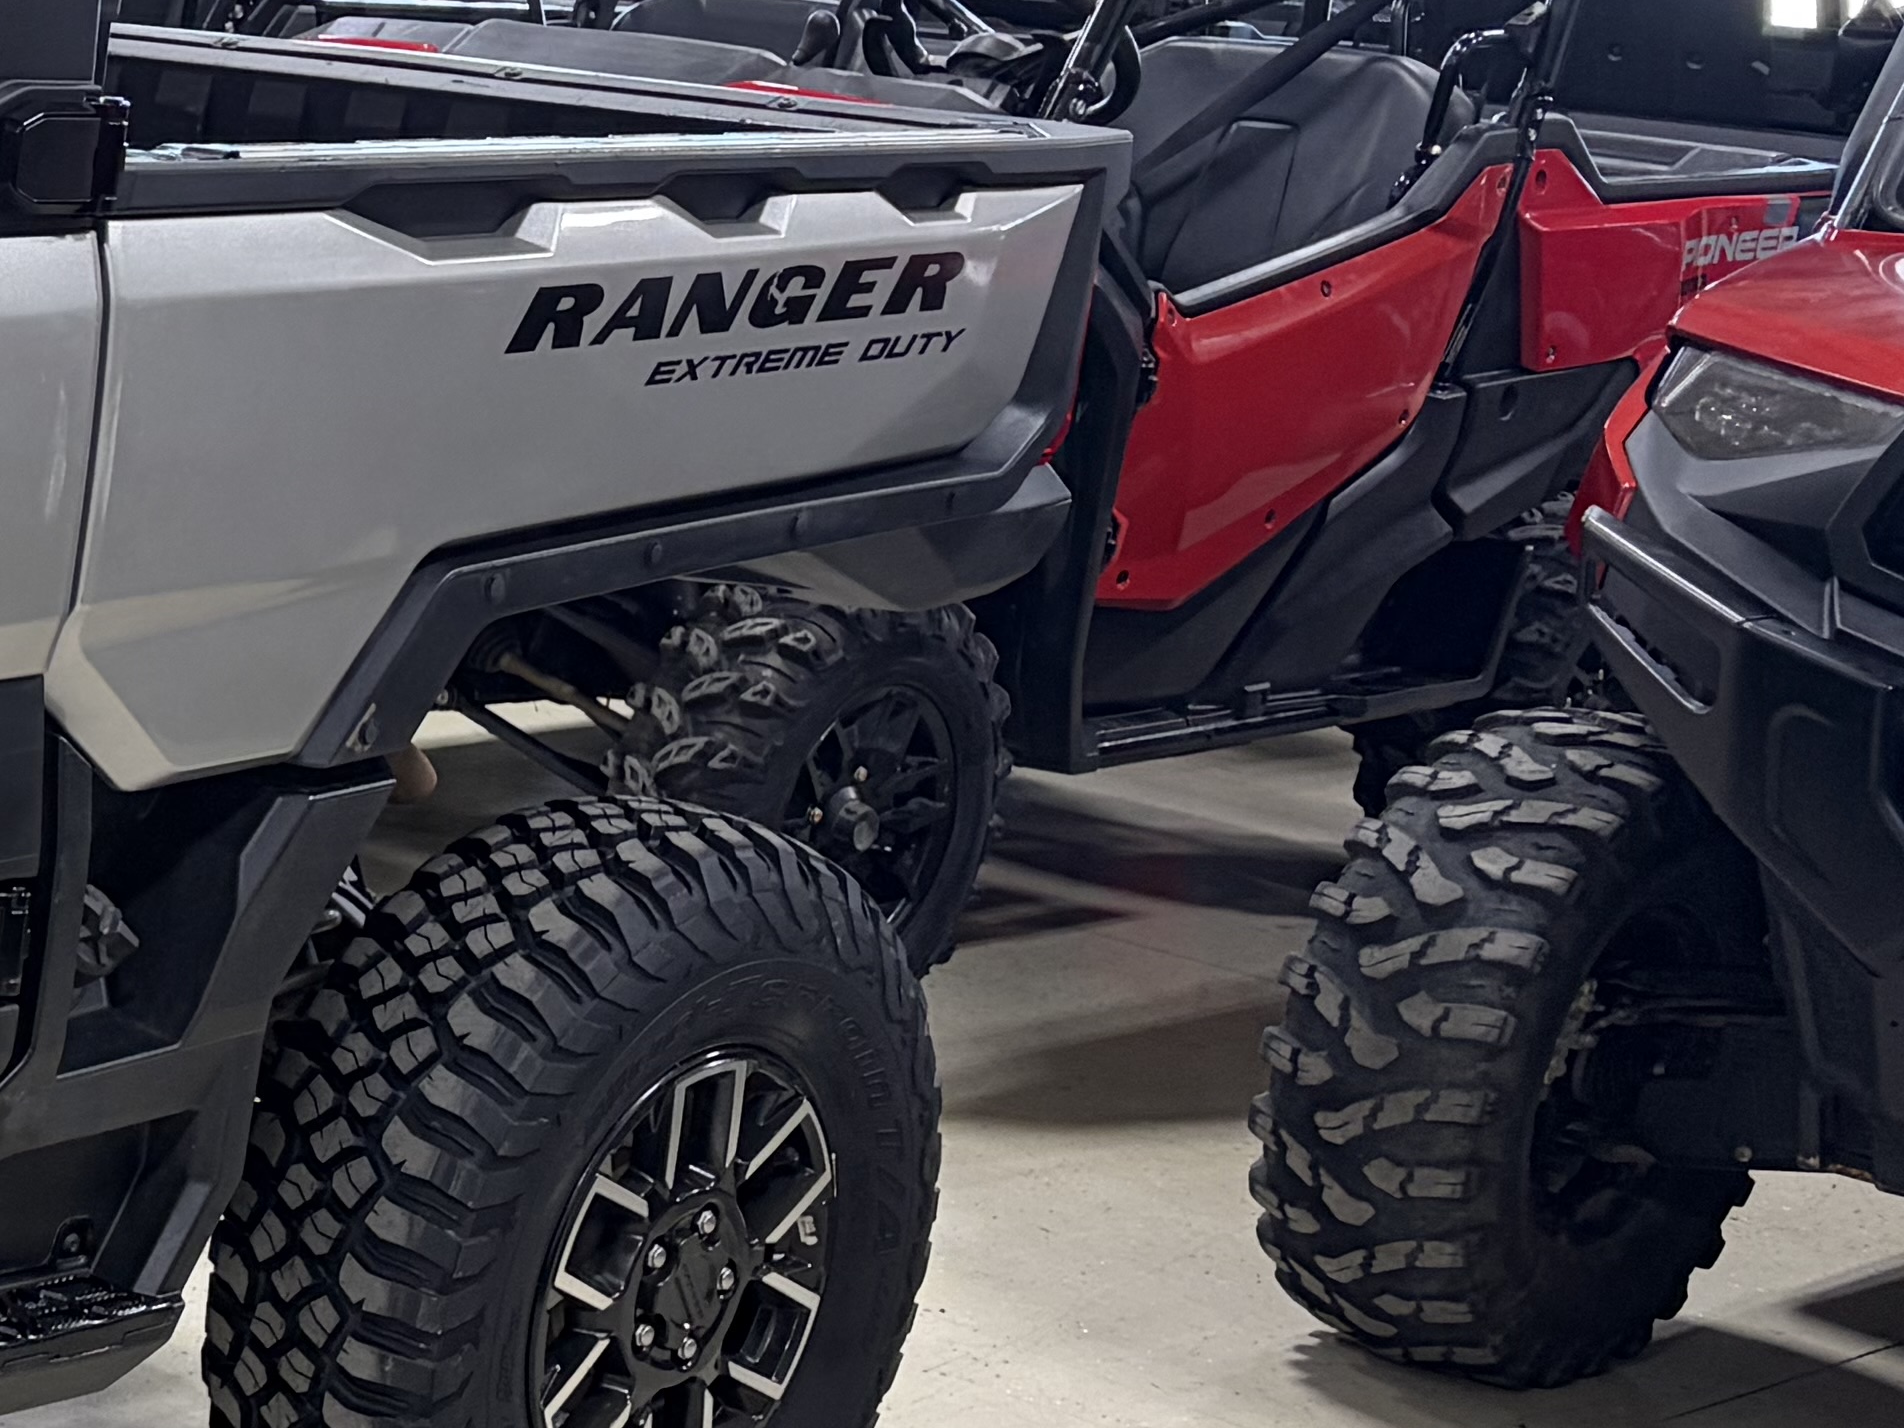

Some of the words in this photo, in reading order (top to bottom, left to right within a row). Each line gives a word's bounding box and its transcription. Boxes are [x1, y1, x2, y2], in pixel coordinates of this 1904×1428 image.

[504, 251, 966, 355] RANGER
[642, 340, 850, 387] EXTREME
[857, 328, 967, 363] DUTY
